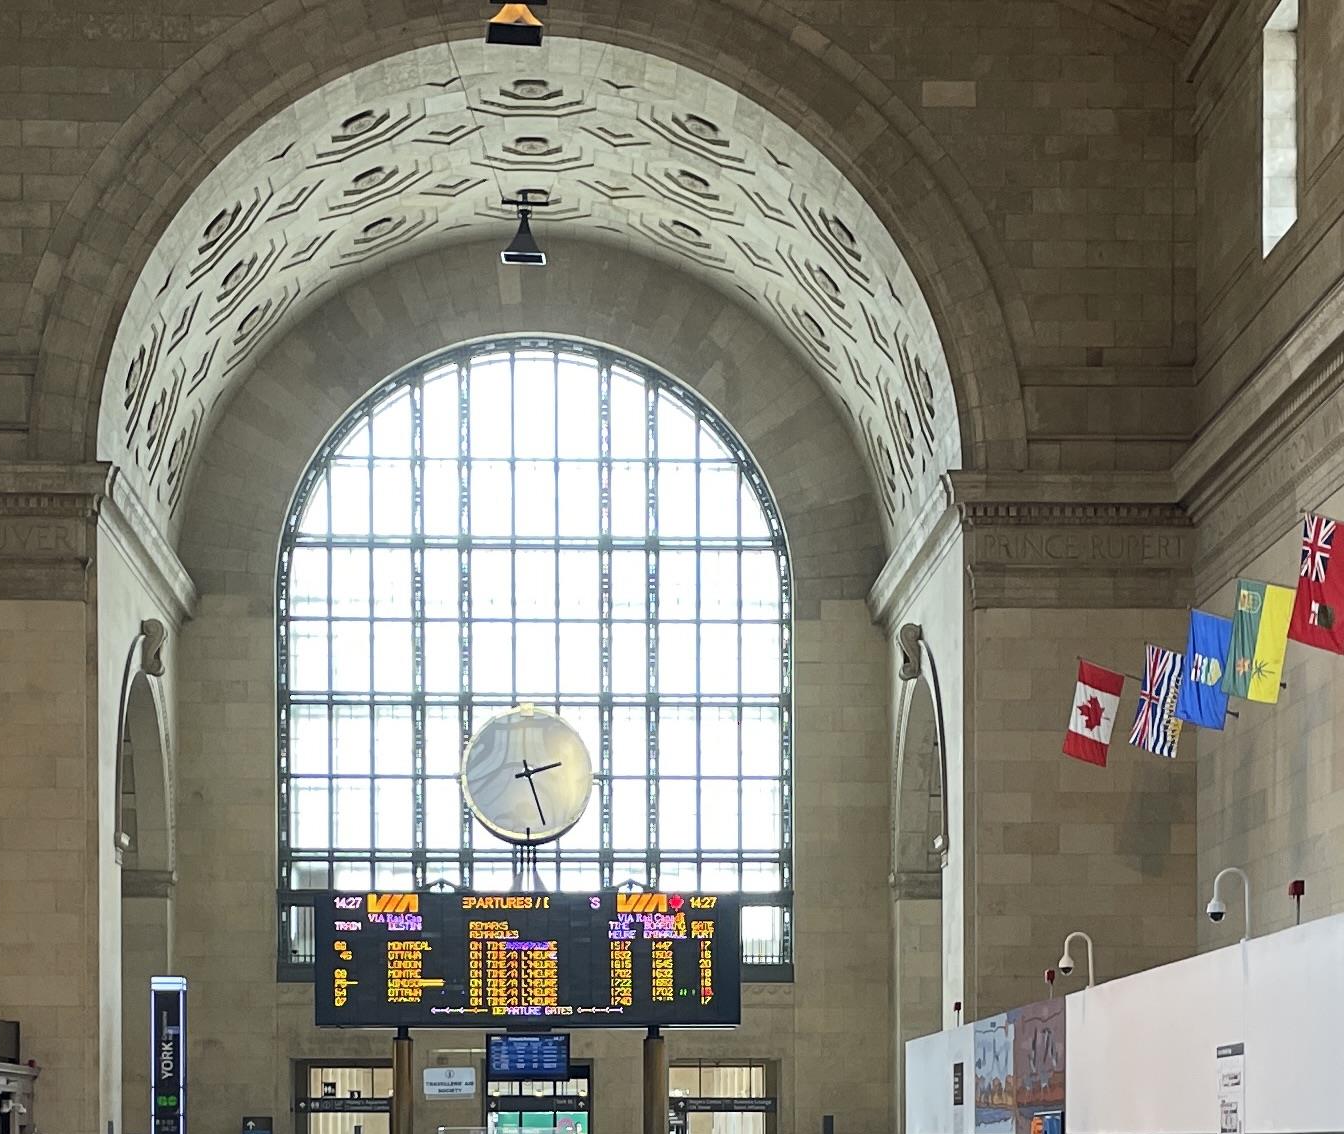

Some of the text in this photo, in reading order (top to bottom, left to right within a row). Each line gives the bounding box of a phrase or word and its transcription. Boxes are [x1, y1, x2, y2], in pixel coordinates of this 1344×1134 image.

[983, 533, 1184, 560] PRINCE RUPERT
[367, 893, 419, 913] VIA
[617, 893, 668, 913] VIA
[469, 921, 509, 931] REMARKS
[608, 920, 630, 930] TIME
[469, 930, 519, 940] REMARQUES
[470, 941, 483, 951] ON
[470, 950, 483, 960] ON
[470, 960, 483, 970] ON
[470, 969, 483, 979] ON
[470, 978, 483, 988] ON
[470, 987, 483, 997] ON
[470, 996, 483, 1007] ON
[492, 1006, 574, 1016] DEPARTURE GATES
[161, 1041, 174, 1080] YORK
